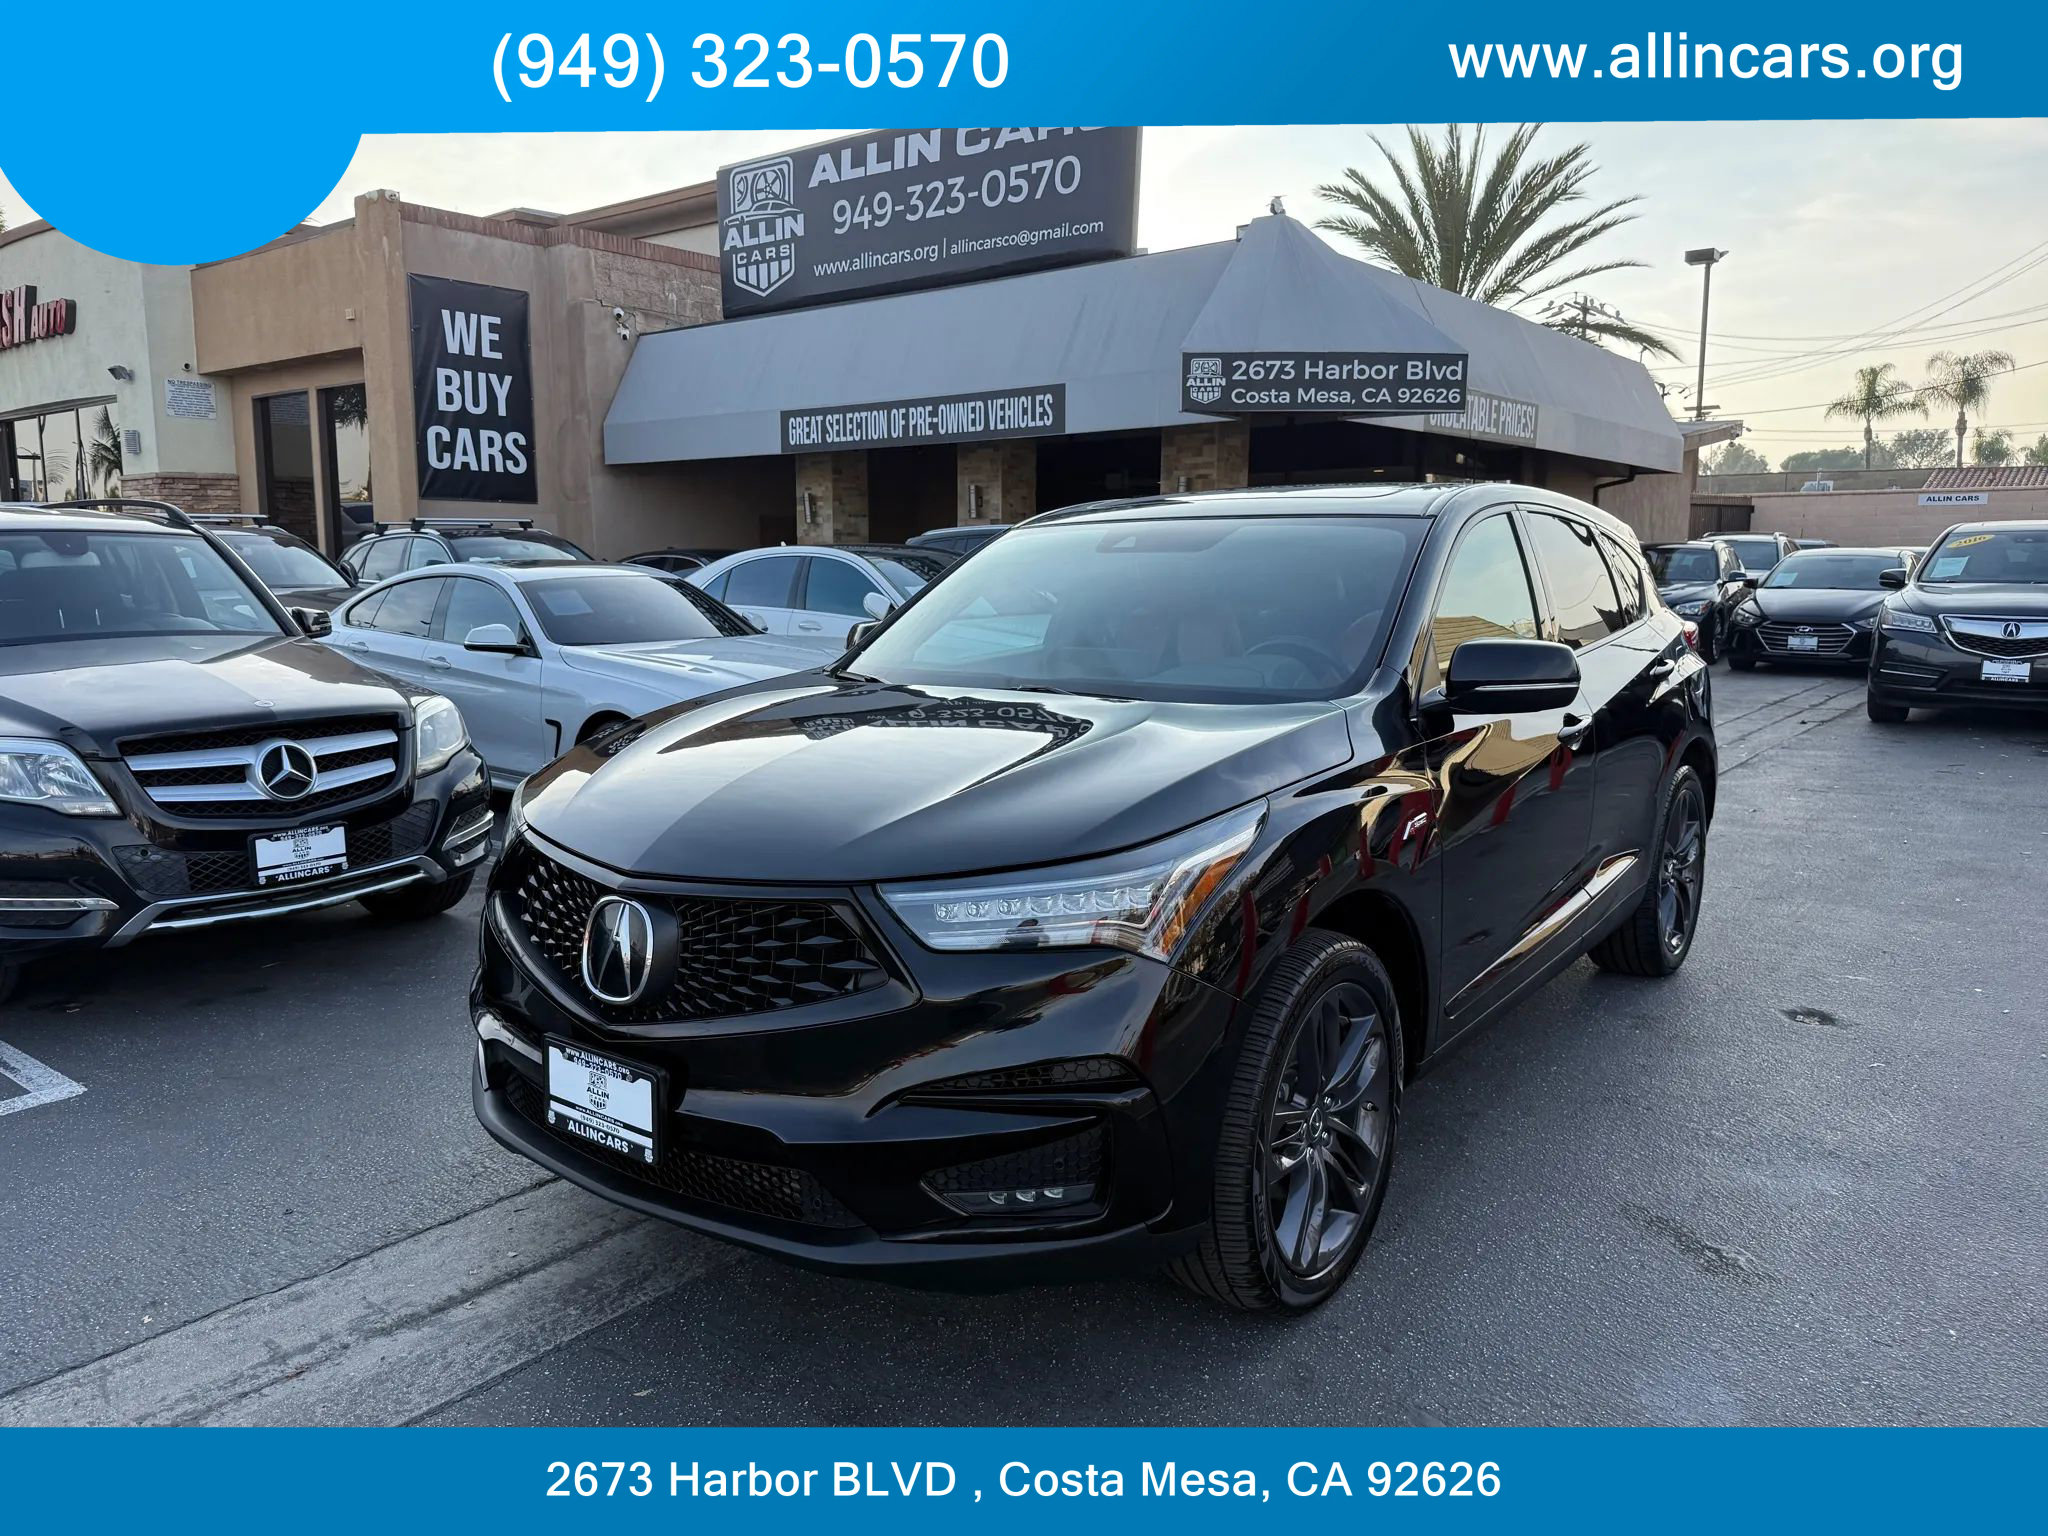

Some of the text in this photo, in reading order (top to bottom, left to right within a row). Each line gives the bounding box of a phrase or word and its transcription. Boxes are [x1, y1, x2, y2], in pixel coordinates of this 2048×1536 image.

[808, 127, 1106, 188] ALLIN CA
[833, 155, 1081, 235] 949-323-0570
[723, 213, 804, 251] ALLIN
[737, 244, 790, 265] CARS
[813, 219, 1104, 277] www.allincars.org allincarsco@gmail.com
[0, 284, 67, 348] SH AUTO
[441, 309, 502, 359] WE
[436, 367, 512, 416] BUY
[1186, 378, 1226, 386] ALLIN
[1232, 359, 1463, 380] 2673 Harbor Blvd
[789, 393, 1053, 445] GREAT SELECTION OF PRE-OWNED VEHICLES
[1231, 388, 1461, 405] Costa Mesa, CA 92626
[1499, 401, 1536, 438] PRICES!
[426, 425, 527, 474] CARS
[587, 1086, 609, 1100] ALLIN
